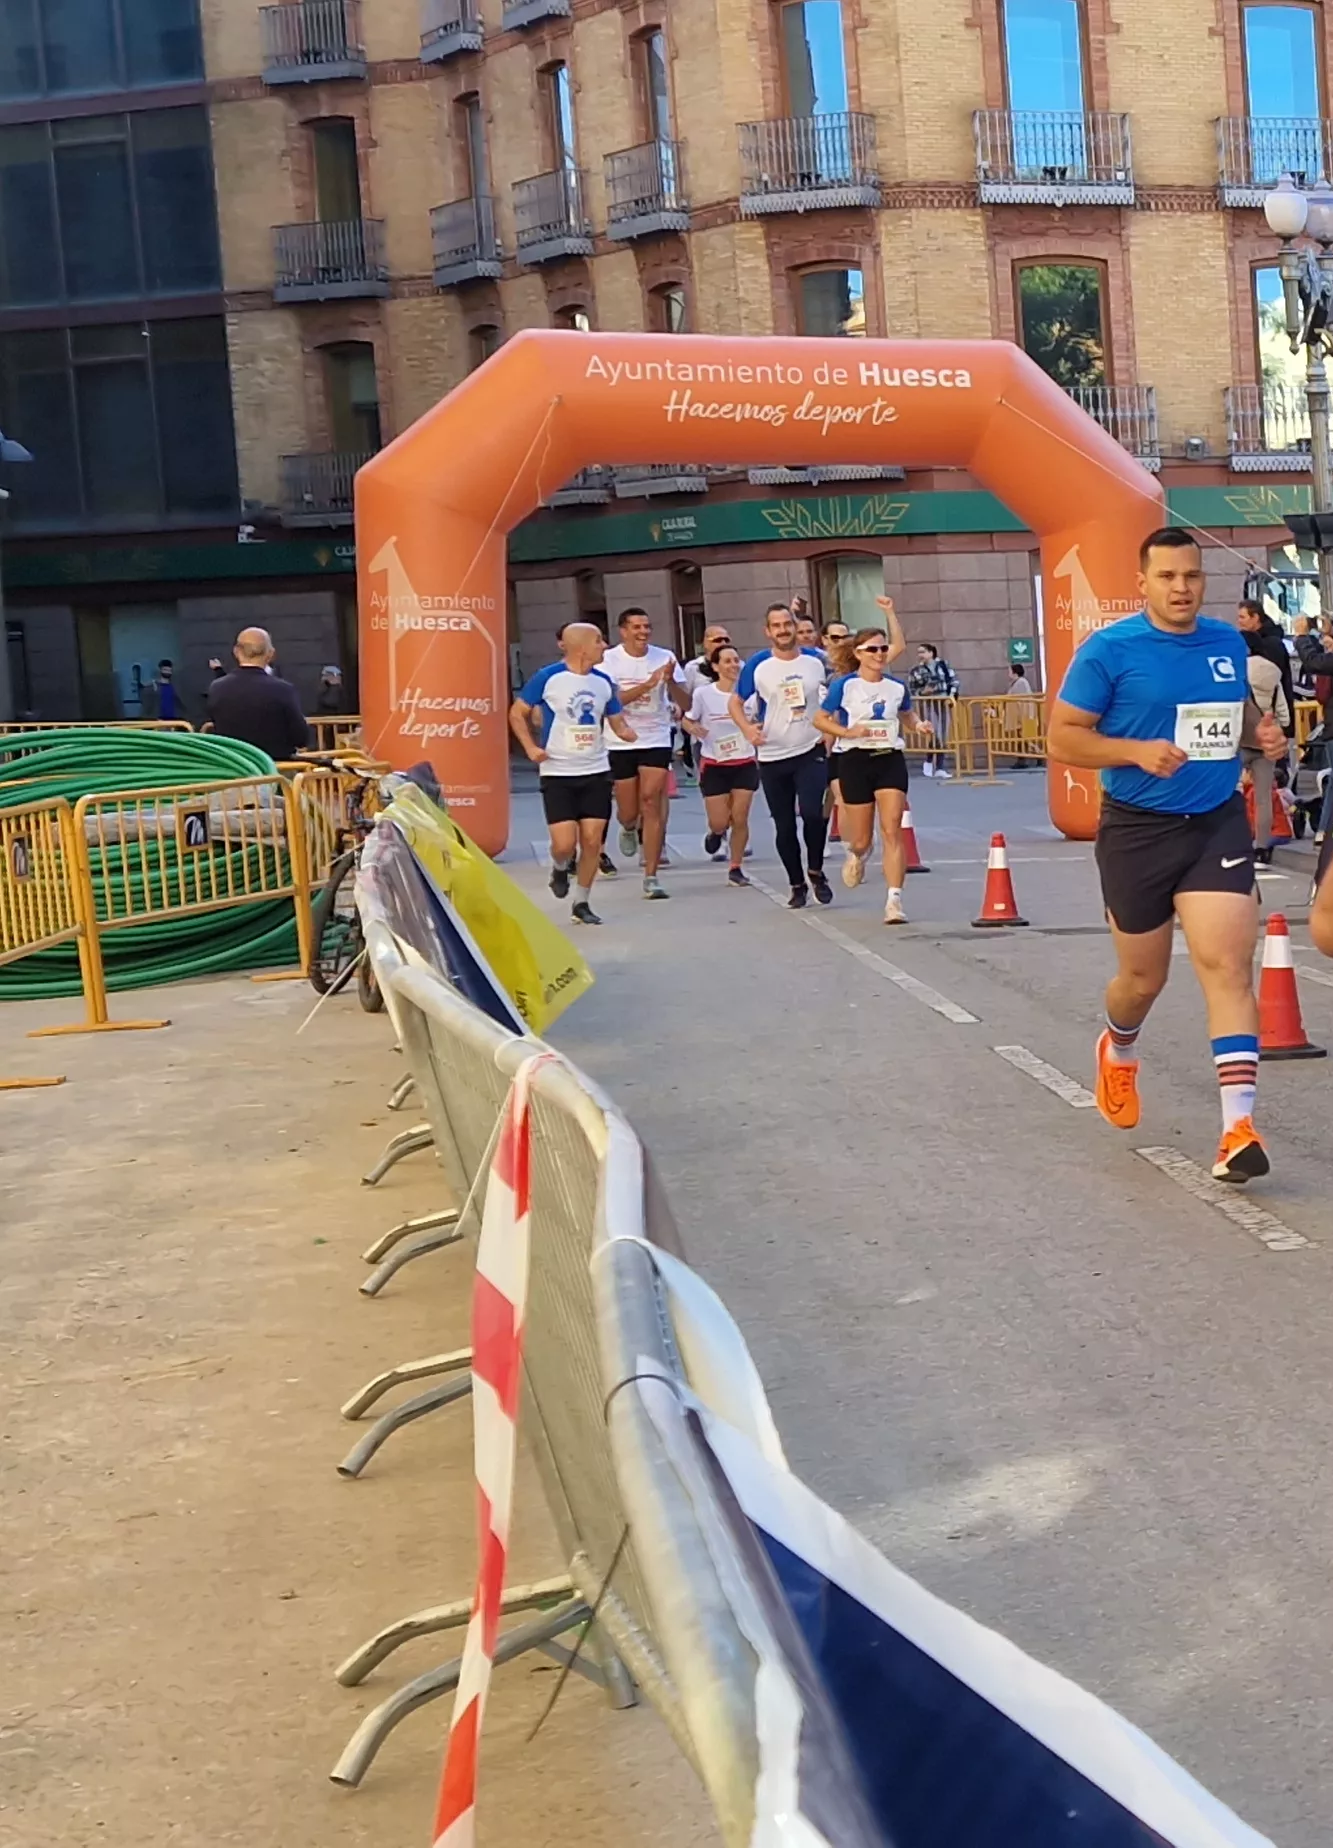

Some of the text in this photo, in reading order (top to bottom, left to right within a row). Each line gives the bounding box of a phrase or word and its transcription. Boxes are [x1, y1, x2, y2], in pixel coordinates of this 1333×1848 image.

[585, 355, 972, 388] Ayuntamiento de Huesca
[663, 389, 900, 436] Hacemos deporte
[370, 591, 495, 612] Ayuntamiento
[371, 615, 472, 631] de Huesca
[1056, 614, 1072, 630] de
[398, 687, 491, 714] Hacemos
[399, 713, 482, 747] deporte
[1193, 721, 1231, 739] 144
[1190, 741, 1234, 749] FRANKLIN
